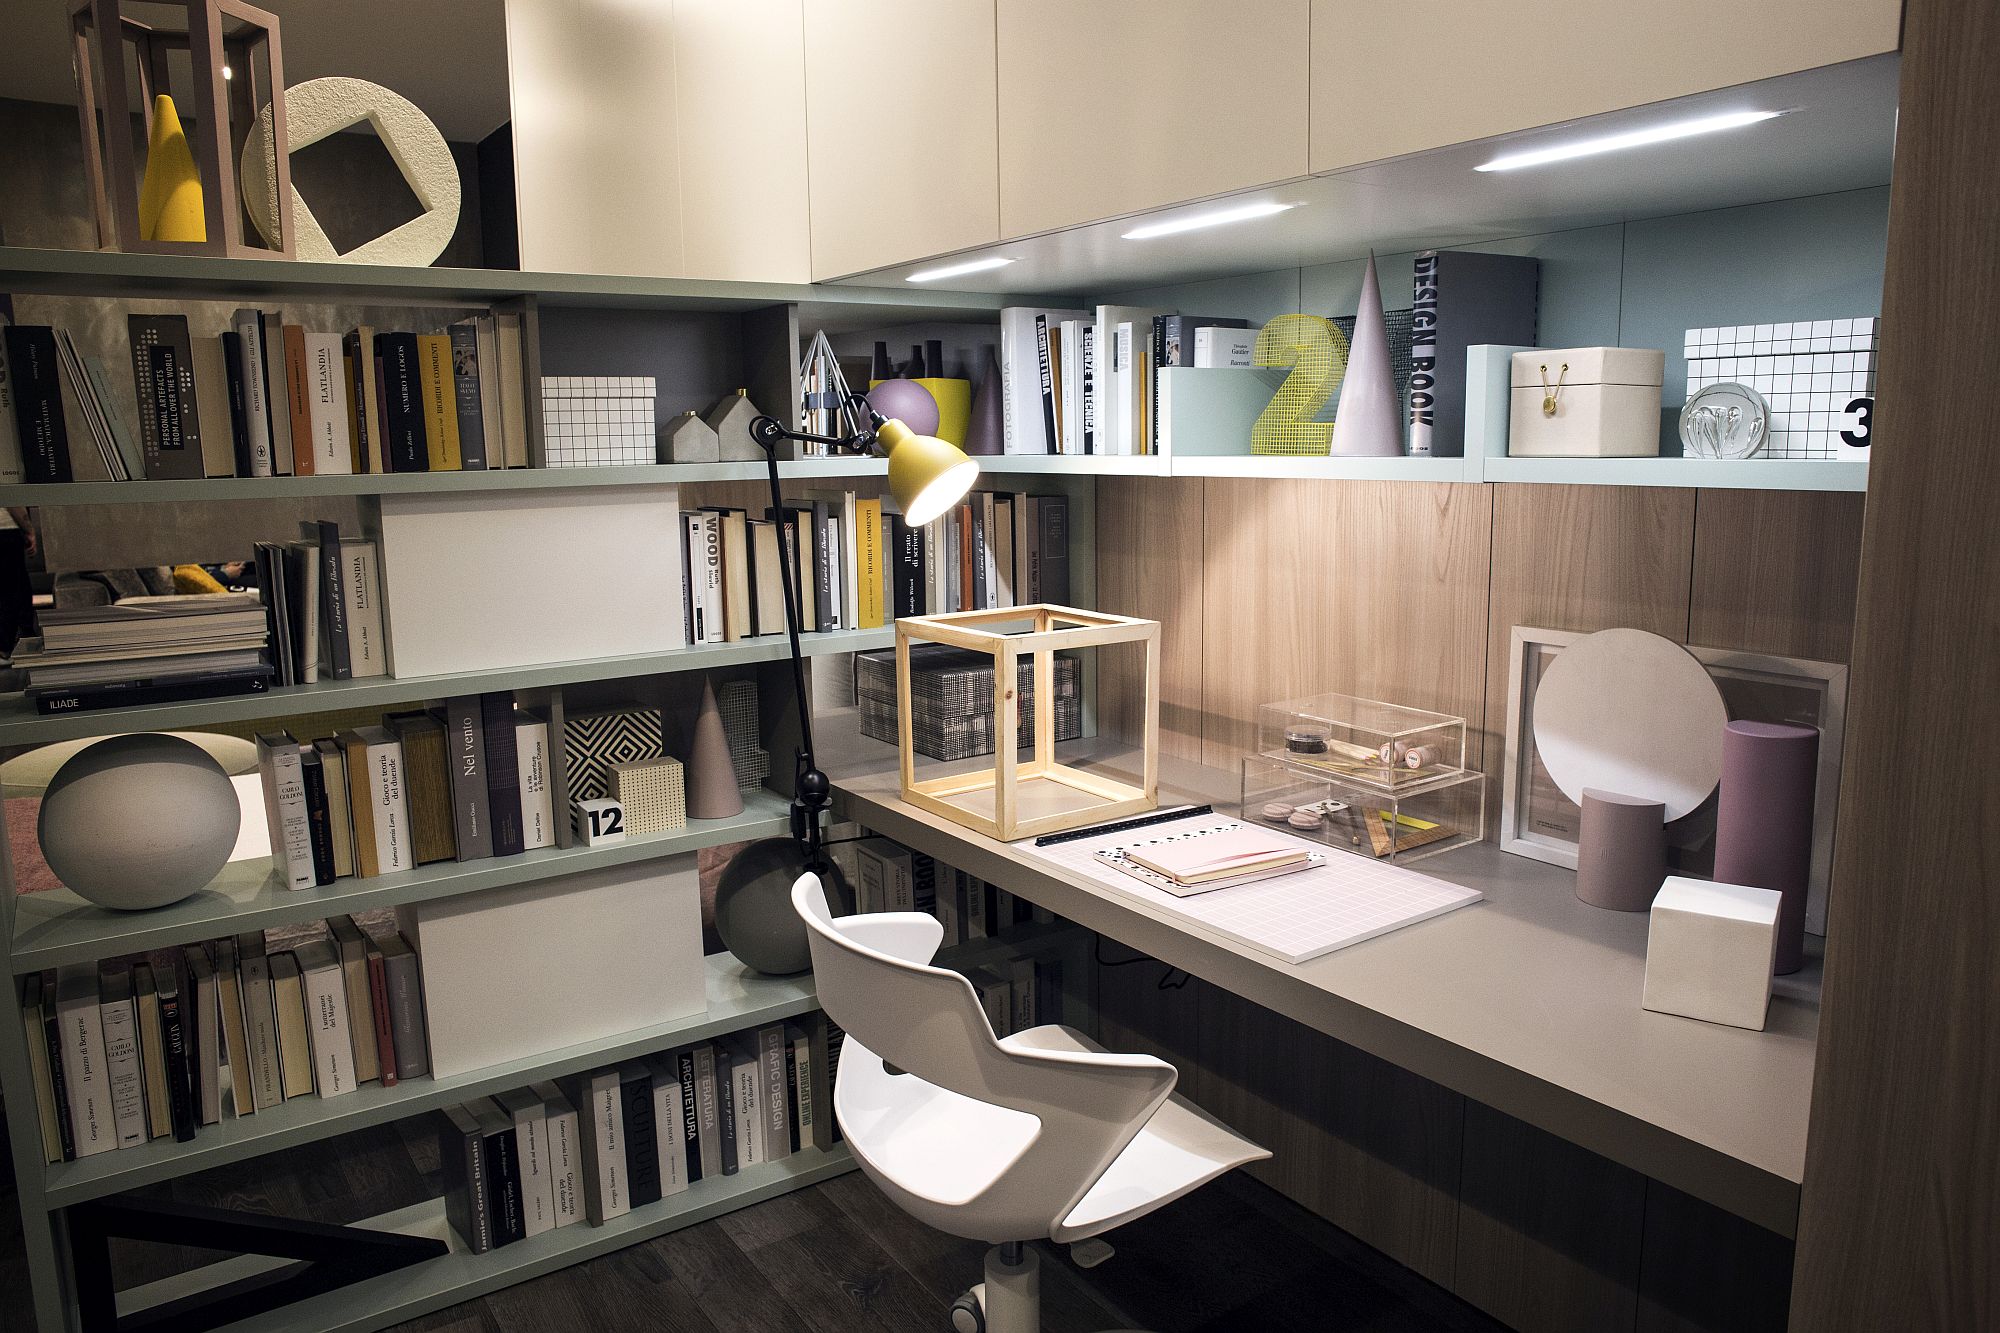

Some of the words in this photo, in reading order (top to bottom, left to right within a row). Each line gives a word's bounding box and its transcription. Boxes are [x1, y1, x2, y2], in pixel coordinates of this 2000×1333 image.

[1413, 256, 1438, 345] DESIGN
[398, 345, 406, 371] LOGOS
[431, 342, 440, 378] COMMENTI
[1037, 322, 1050, 394] ARCHITETTURA
[1084, 332, 1093, 374] SCIENZE
[1120, 328, 1128, 370] MUSICA
[164, 353, 174, 378] WORLD
[318, 348, 328, 403] FLATLANDIA
[157, 369, 168, 408] ARTEFACTS
[168, 379, 176, 392] THE
[402, 382, 410, 413] NUMERO
[435, 386, 444, 414] RICORDI
[1410, 357, 1436, 427] BOOK
[170, 394, 178, 412] OVER
[1004, 362, 1012, 448] FOTOGRAFIA
[1084, 390, 1093, 433] TECNICA
[162, 410, 171, 446] PERSONAL
[173, 426, 181, 446] FROM
[1840, 397, 1874, 448] 3
[706, 517, 720, 566] WOOD
[904, 534, 912, 554] reato
[911, 528, 919, 558] scrivere
[354, 556, 364, 610] FLATLANDIA
[48, 698, 80, 710] ILIADE
[462, 717, 474, 752] vento
[379, 755, 388, 777] teoria
[388, 758, 398, 786] duende
[464, 754, 476, 776] Nel
[382, 784, 391, 806] Gioco
[391, 788, 399, 800] del
[588, 807, 624, 838] 12
[391, 846, 400, 867] Federico
[326, 994, 336, 1017] Majestic
[77, 1018, 88, 1046] Bergerac
[110, 1043, 130, 1052] CARLO
[80, 1047, 87, 1055] di
[82, 1056, 92, 1075] pazzo
[769, 1034, 782, 1077] GRAFIC
[700, 1054, 714, 1129] LETTERATURA
[799, 1060, 810, 1101] EXPERIENCE
[605, 1088, 614, 1112] Maigret
[682, 1058, 696, 1140] ARCHITETTURA
[771, 1084, 783, 1130] DESIGN
[802, 1102, 811, 1126] ONLINE
[631, 1084, 650, 1188] SCULTURE
[472, 1140, 481, 1178] Britain
[476, 1180, 484, 1210] Great
[478, 1212, 488, 1251] Jamie's
